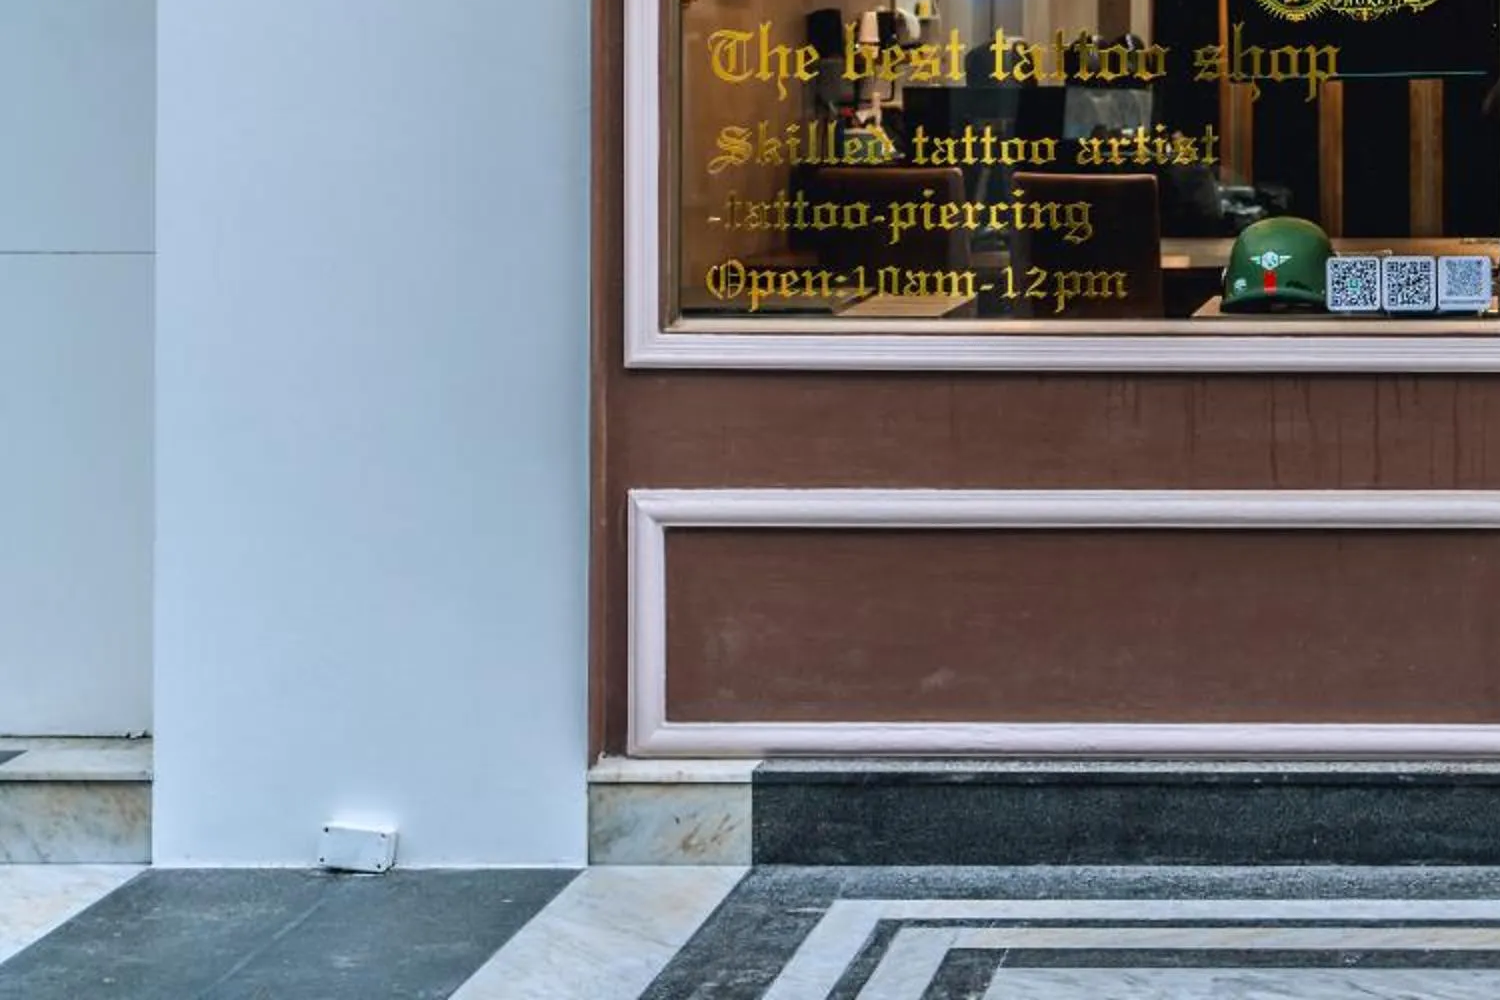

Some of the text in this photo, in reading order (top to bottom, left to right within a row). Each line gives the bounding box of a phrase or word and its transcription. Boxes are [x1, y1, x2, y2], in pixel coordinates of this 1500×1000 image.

[707, 21, 1341, 103] The best tattoo shop
[706, 121, 1221, 174] Skilled tattoo artist
